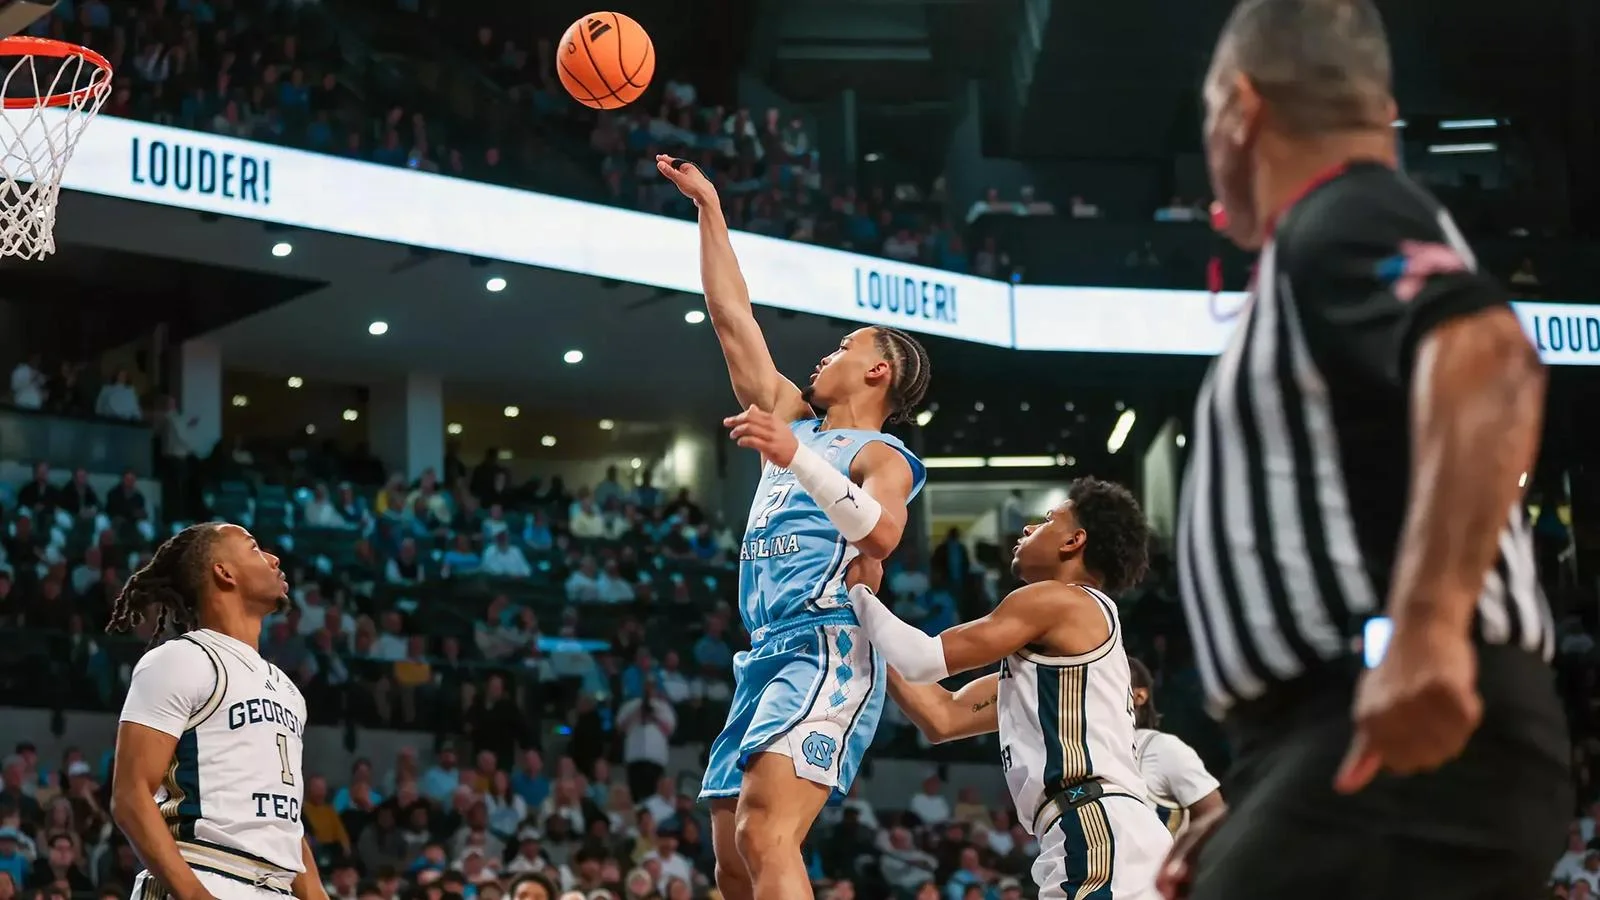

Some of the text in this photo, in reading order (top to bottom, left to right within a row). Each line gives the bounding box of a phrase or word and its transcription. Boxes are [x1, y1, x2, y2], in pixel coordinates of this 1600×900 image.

[132, 137, 270, 205] LOUDER!
[855, 267, 957, 323] LOUDER!
[754, 483, 795, 530] 7
[229, 698, 303, 738] GEORGI
[276, 733, 295, 787] 1
